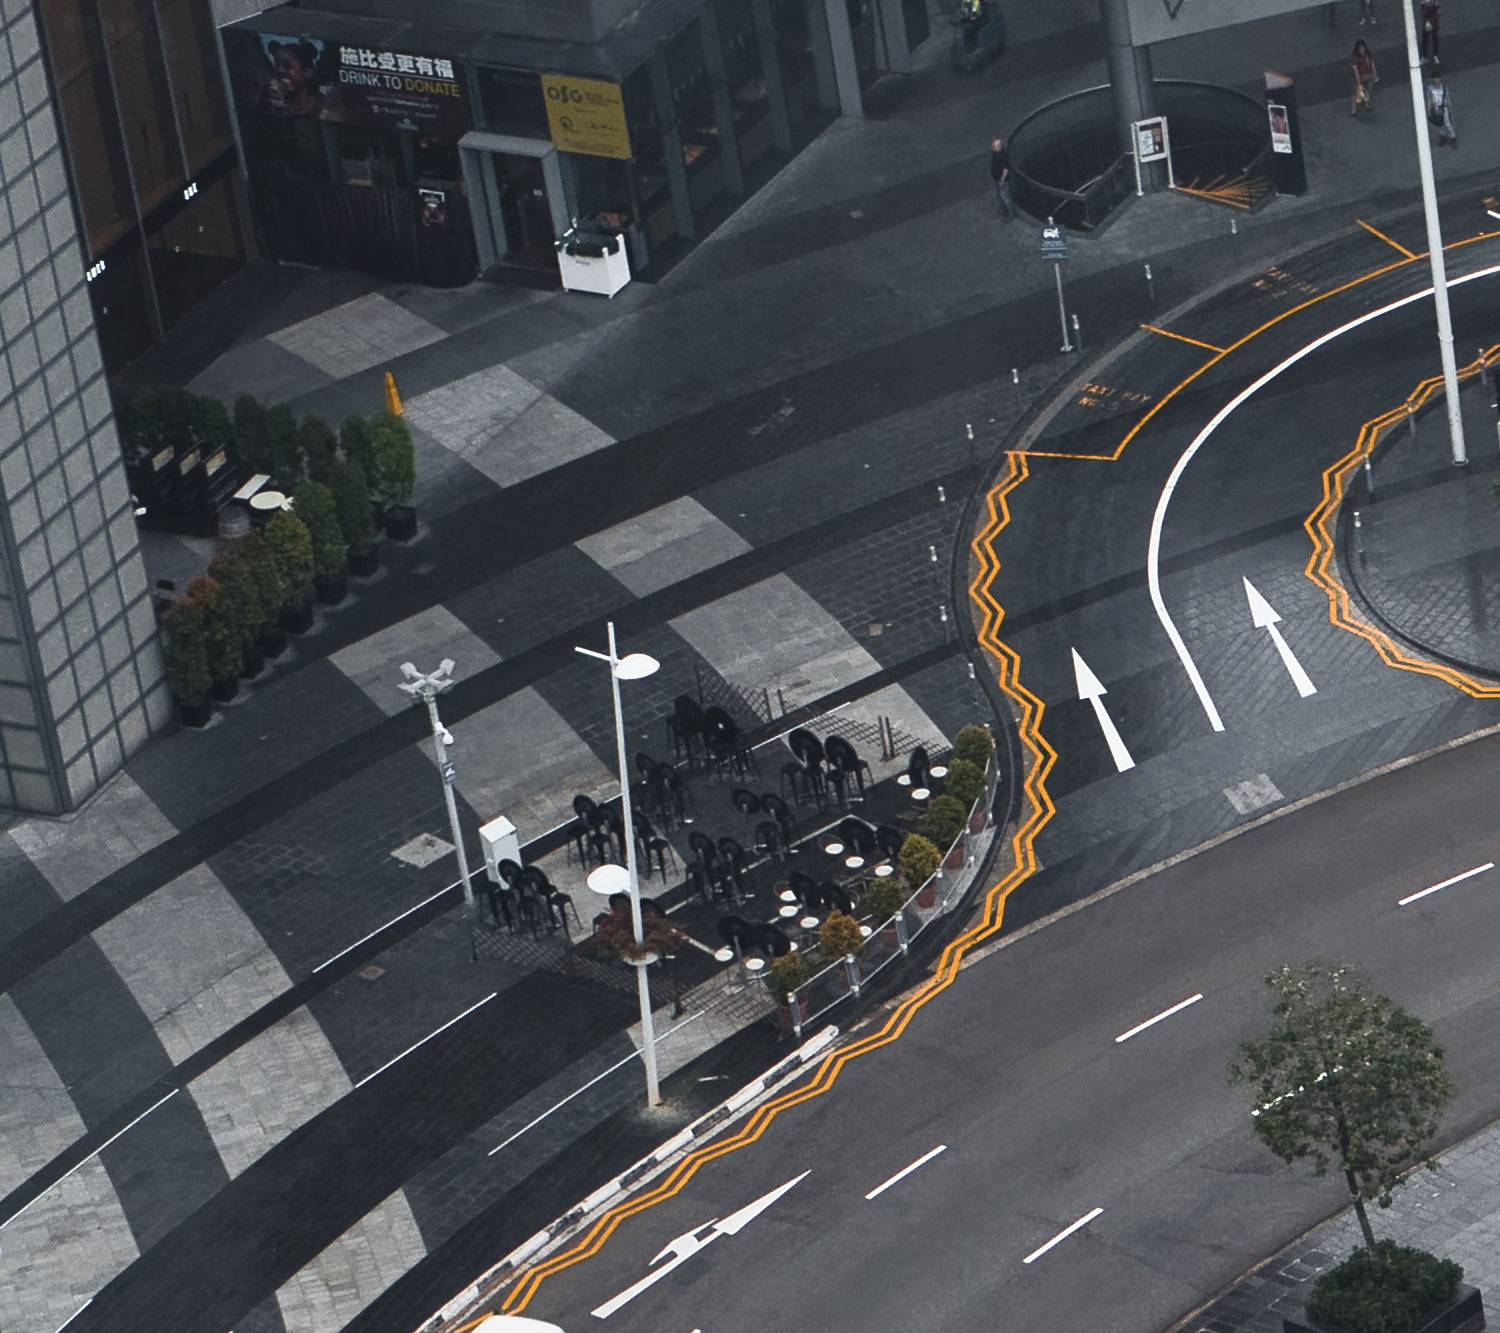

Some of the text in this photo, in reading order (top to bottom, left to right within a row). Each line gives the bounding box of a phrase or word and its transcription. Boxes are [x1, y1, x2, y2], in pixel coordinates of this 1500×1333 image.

[339, 69, 381, 87] DRINK
[383, 75, 402, 90] TO
[405, 79, 461, 98] DONATE
